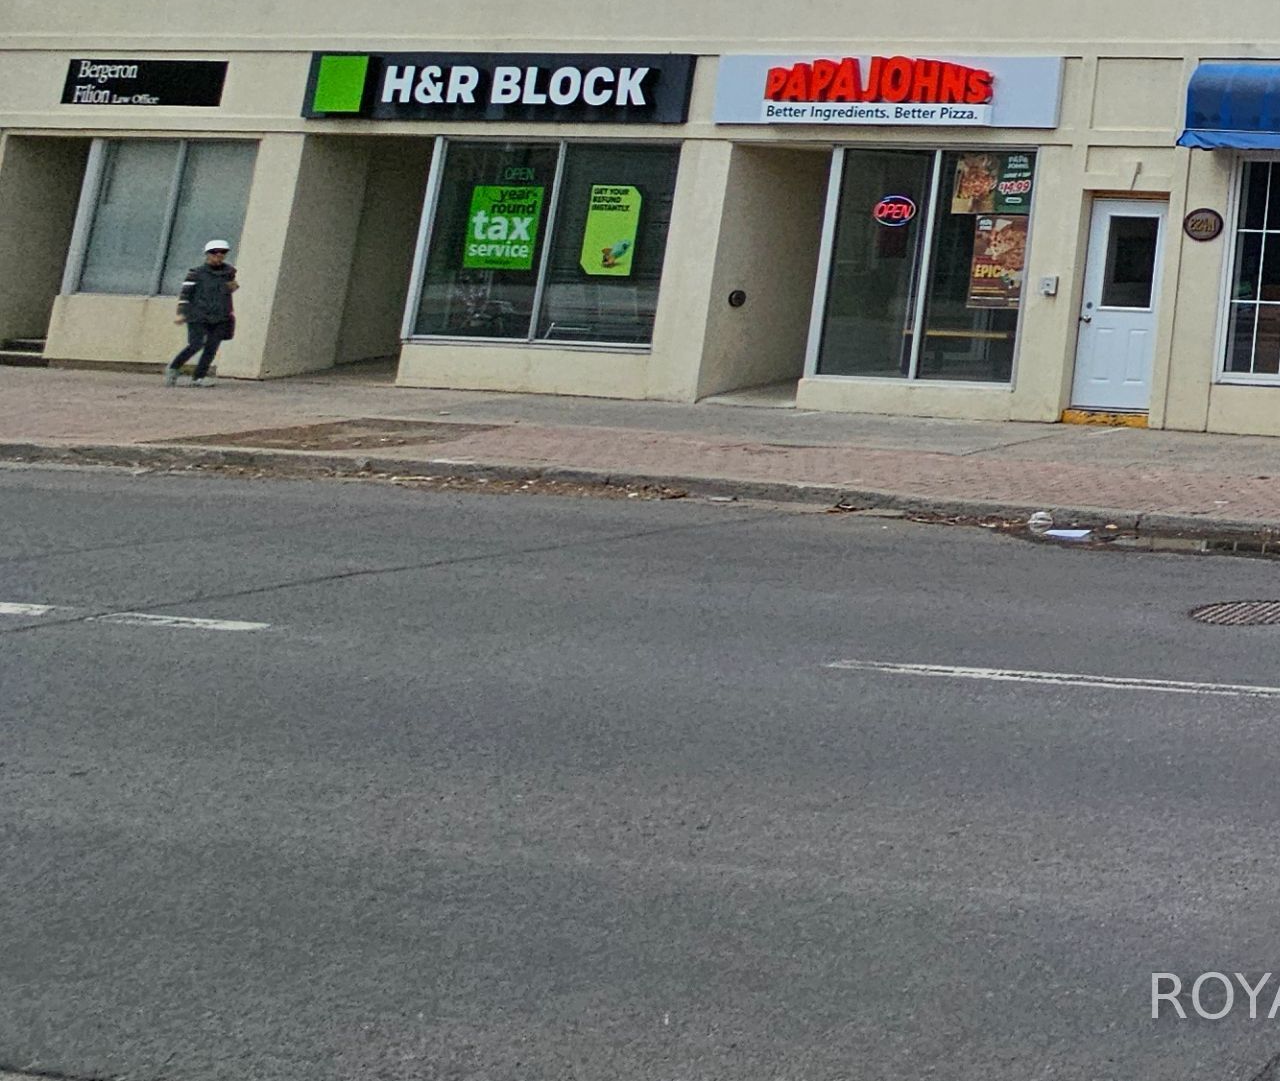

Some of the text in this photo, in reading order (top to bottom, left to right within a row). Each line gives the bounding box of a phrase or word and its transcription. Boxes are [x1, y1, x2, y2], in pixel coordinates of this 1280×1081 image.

[78, 60, 138, 83] Bergeron
[764, 56, 993, 104] PAPA JOHNS
[73, 84, 111, 104] Filion
[132, 94, 160, 105] Office
[381, 65, 650, 106] H&R BLOCK
[766, 105, 978, 121] Better Ingredients. Better Pizza.
[491, 200, 538, 213] round
[876, 204, 912, 218] OPEN
[472, 210, 533, 241] tax
[468, 241, 529, 258] service
